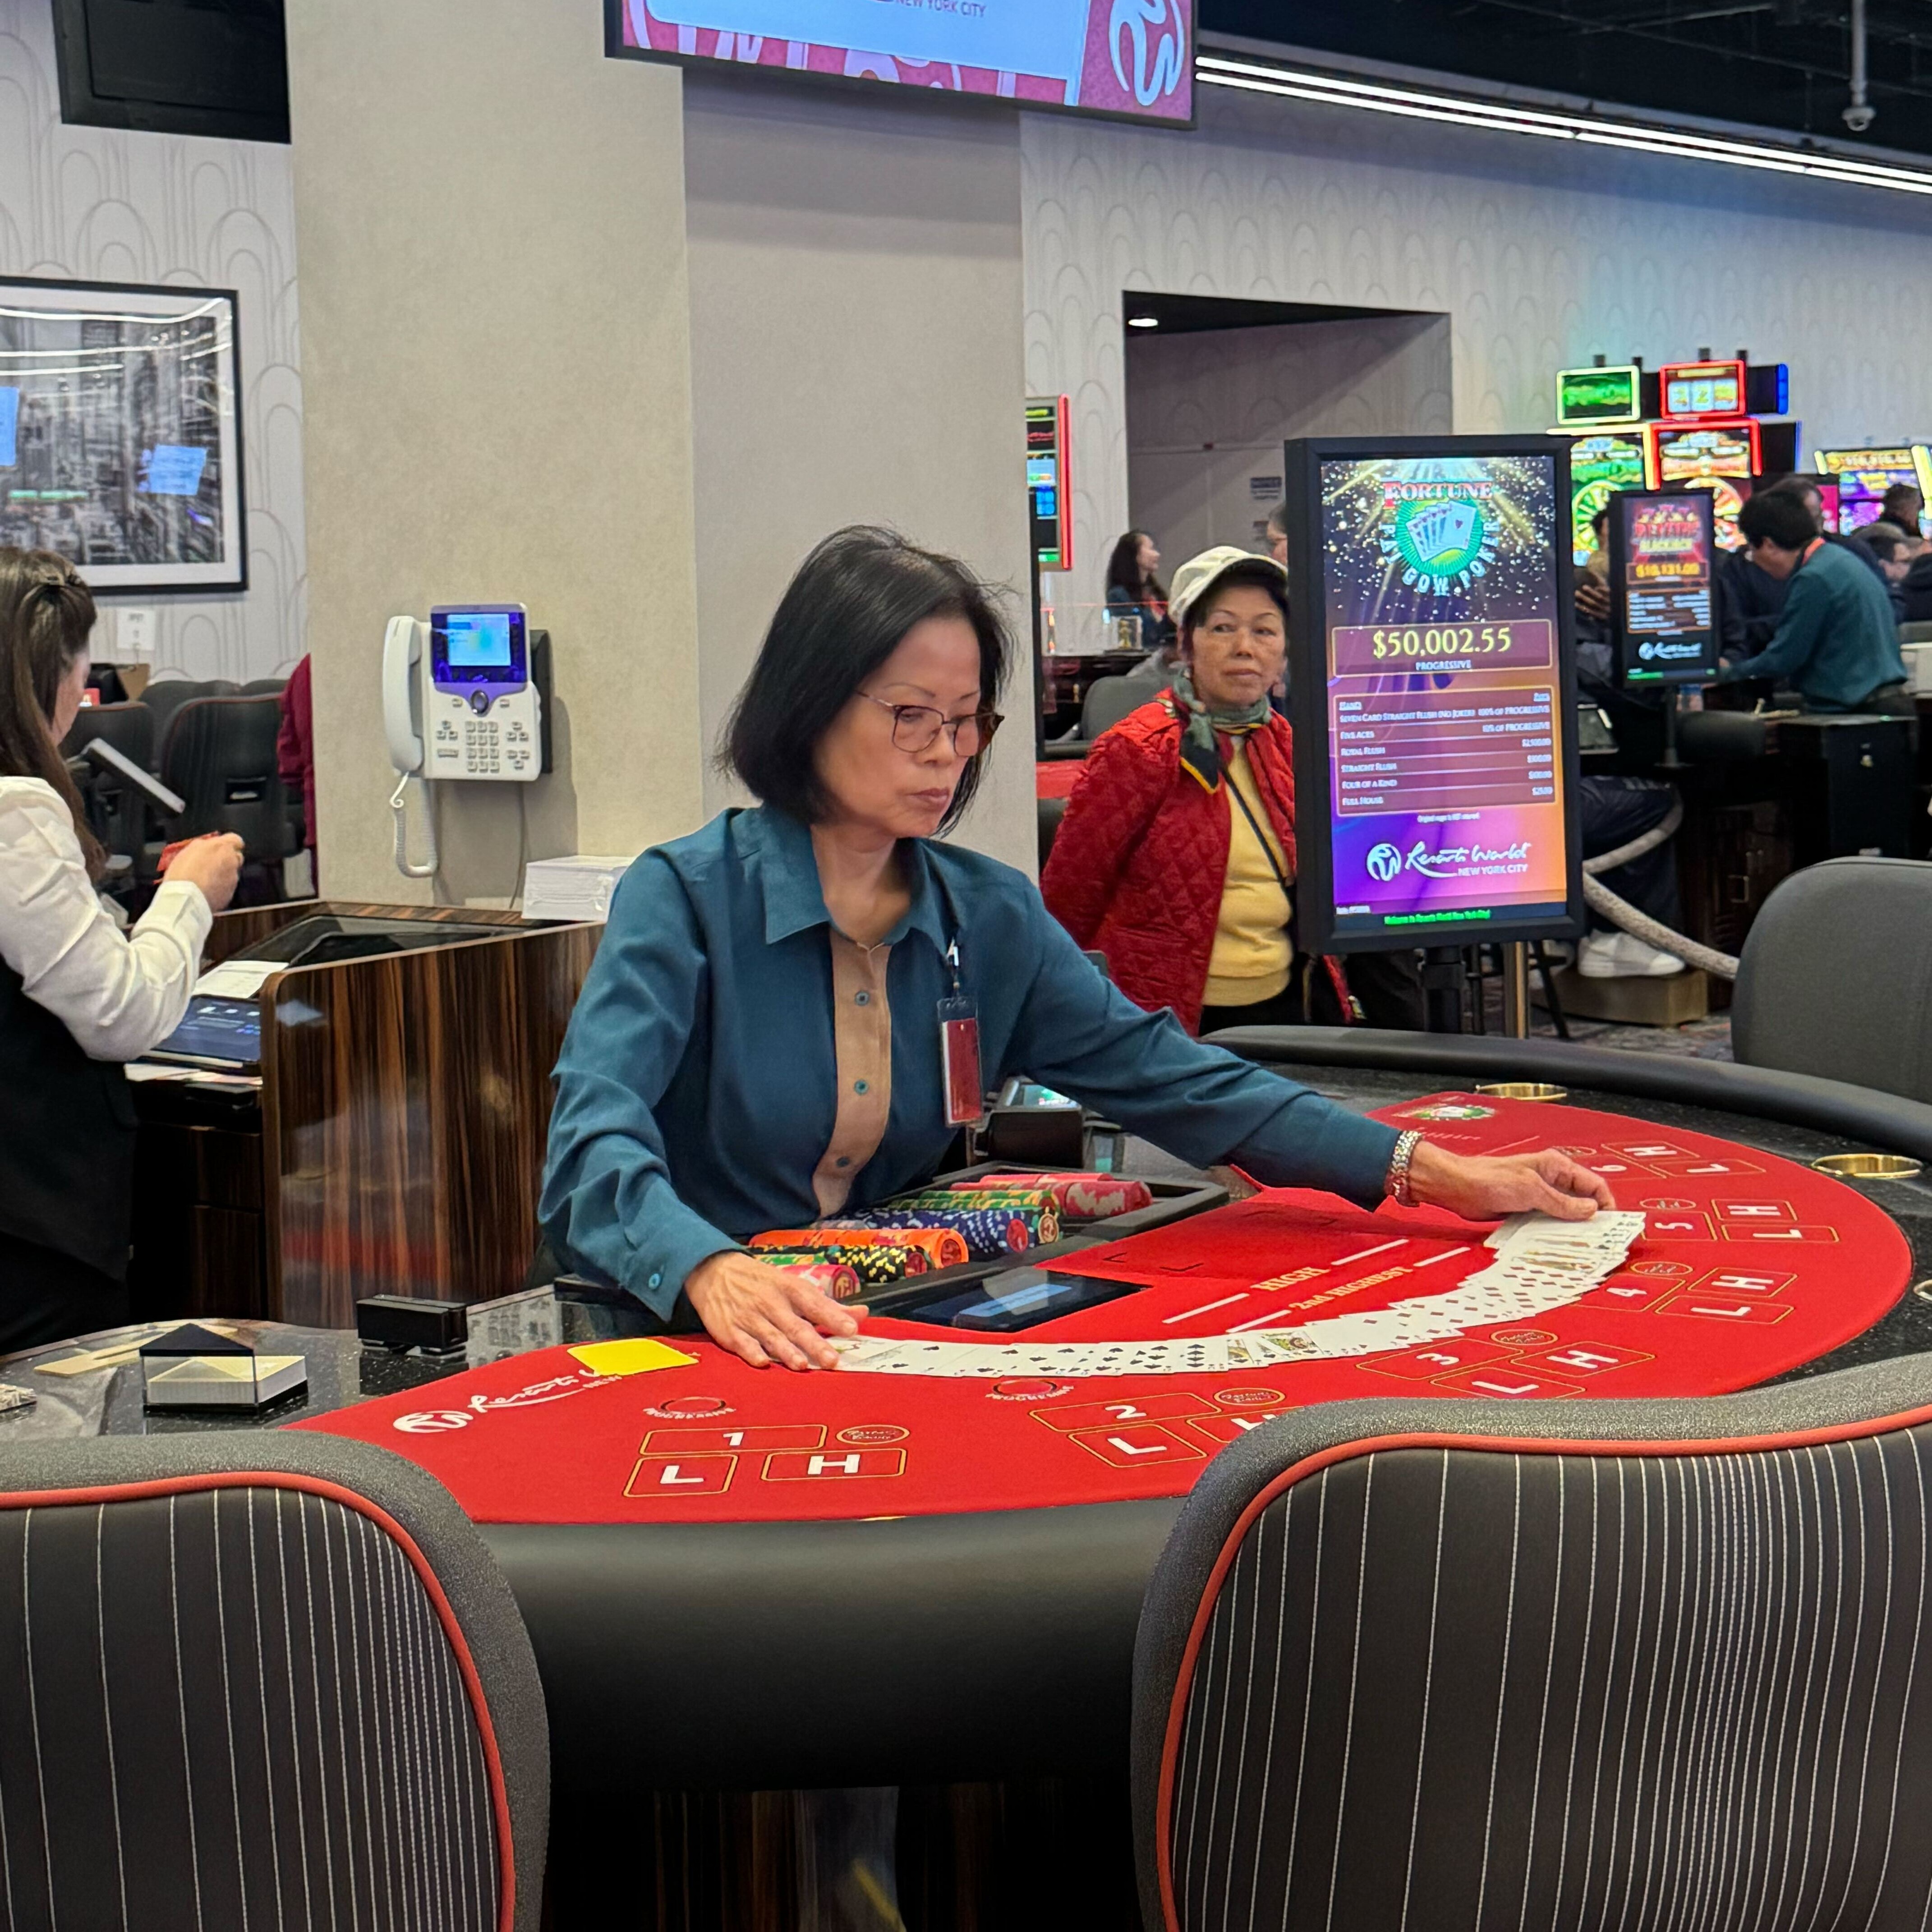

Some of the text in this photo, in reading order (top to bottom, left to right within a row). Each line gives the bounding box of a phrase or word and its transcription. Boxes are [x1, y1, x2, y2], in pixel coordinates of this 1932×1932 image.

[961, 1, 986, 18] CITY
[1383, 481, 1492, 509] FORTUNE
[1402, 566, 1450, 596] GOW
[1459, 521, 1500, 589] POKER
[1373, 627, 1511, 658] $50,002.55
[1416, 660, 1472, 671] PROGRESSIVE
[1405, 841, 1532, 874] Resorts World
[1458, 864, 1528, 876] NEW YORK CITY
[1250, 1267, 1330, 1291] HIGH
[1288, 1266, 1414, 1310] 2nd HIGHEST
[1416, 1353, 1460, 1366] 3
[1546, 1350, 1619, 1369] H
[1471, 1380, 1539, 1394] L
[1104, 1404, 1147, 1420] 2
[722, 1431, 744, 1446] 1
[1107, 1437, 1168, 1455] L
[807, 1454, 861, 1475] H
[660, 1465, 704, 1484] L
